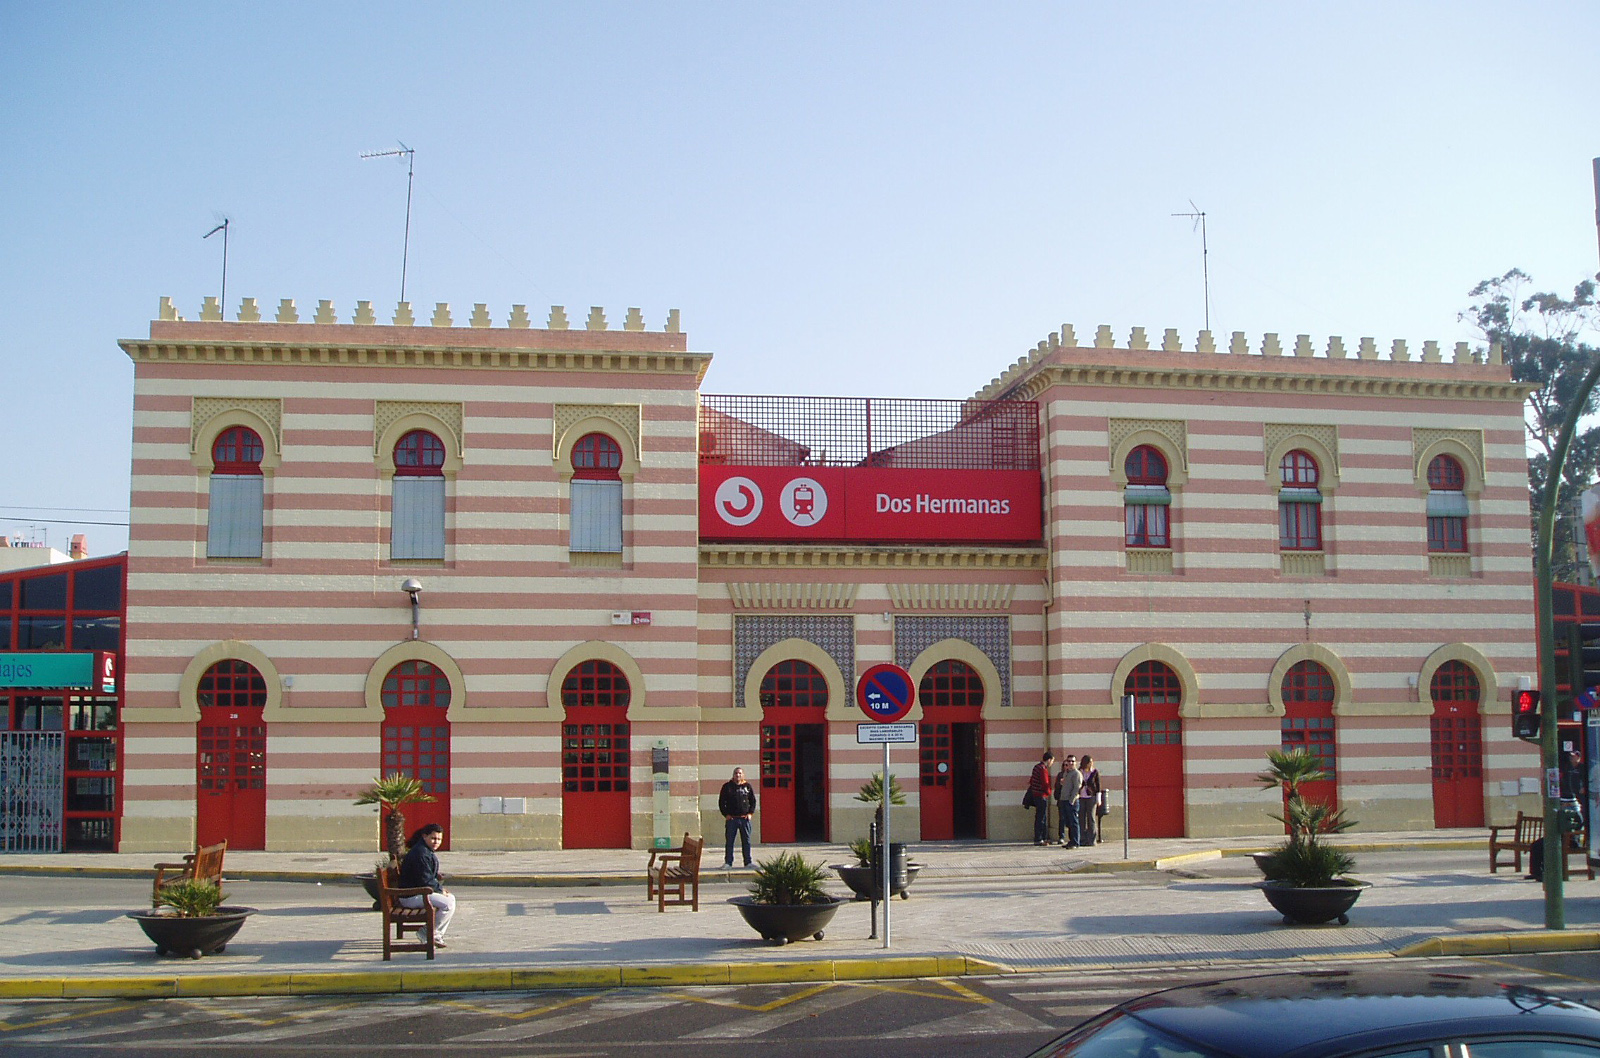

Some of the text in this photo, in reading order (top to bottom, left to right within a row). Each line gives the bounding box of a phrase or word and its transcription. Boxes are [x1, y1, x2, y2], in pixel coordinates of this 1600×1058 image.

[876, 493, 1010, 514] Dos Hermanas
[870, 702, 889, 710] 10 M
